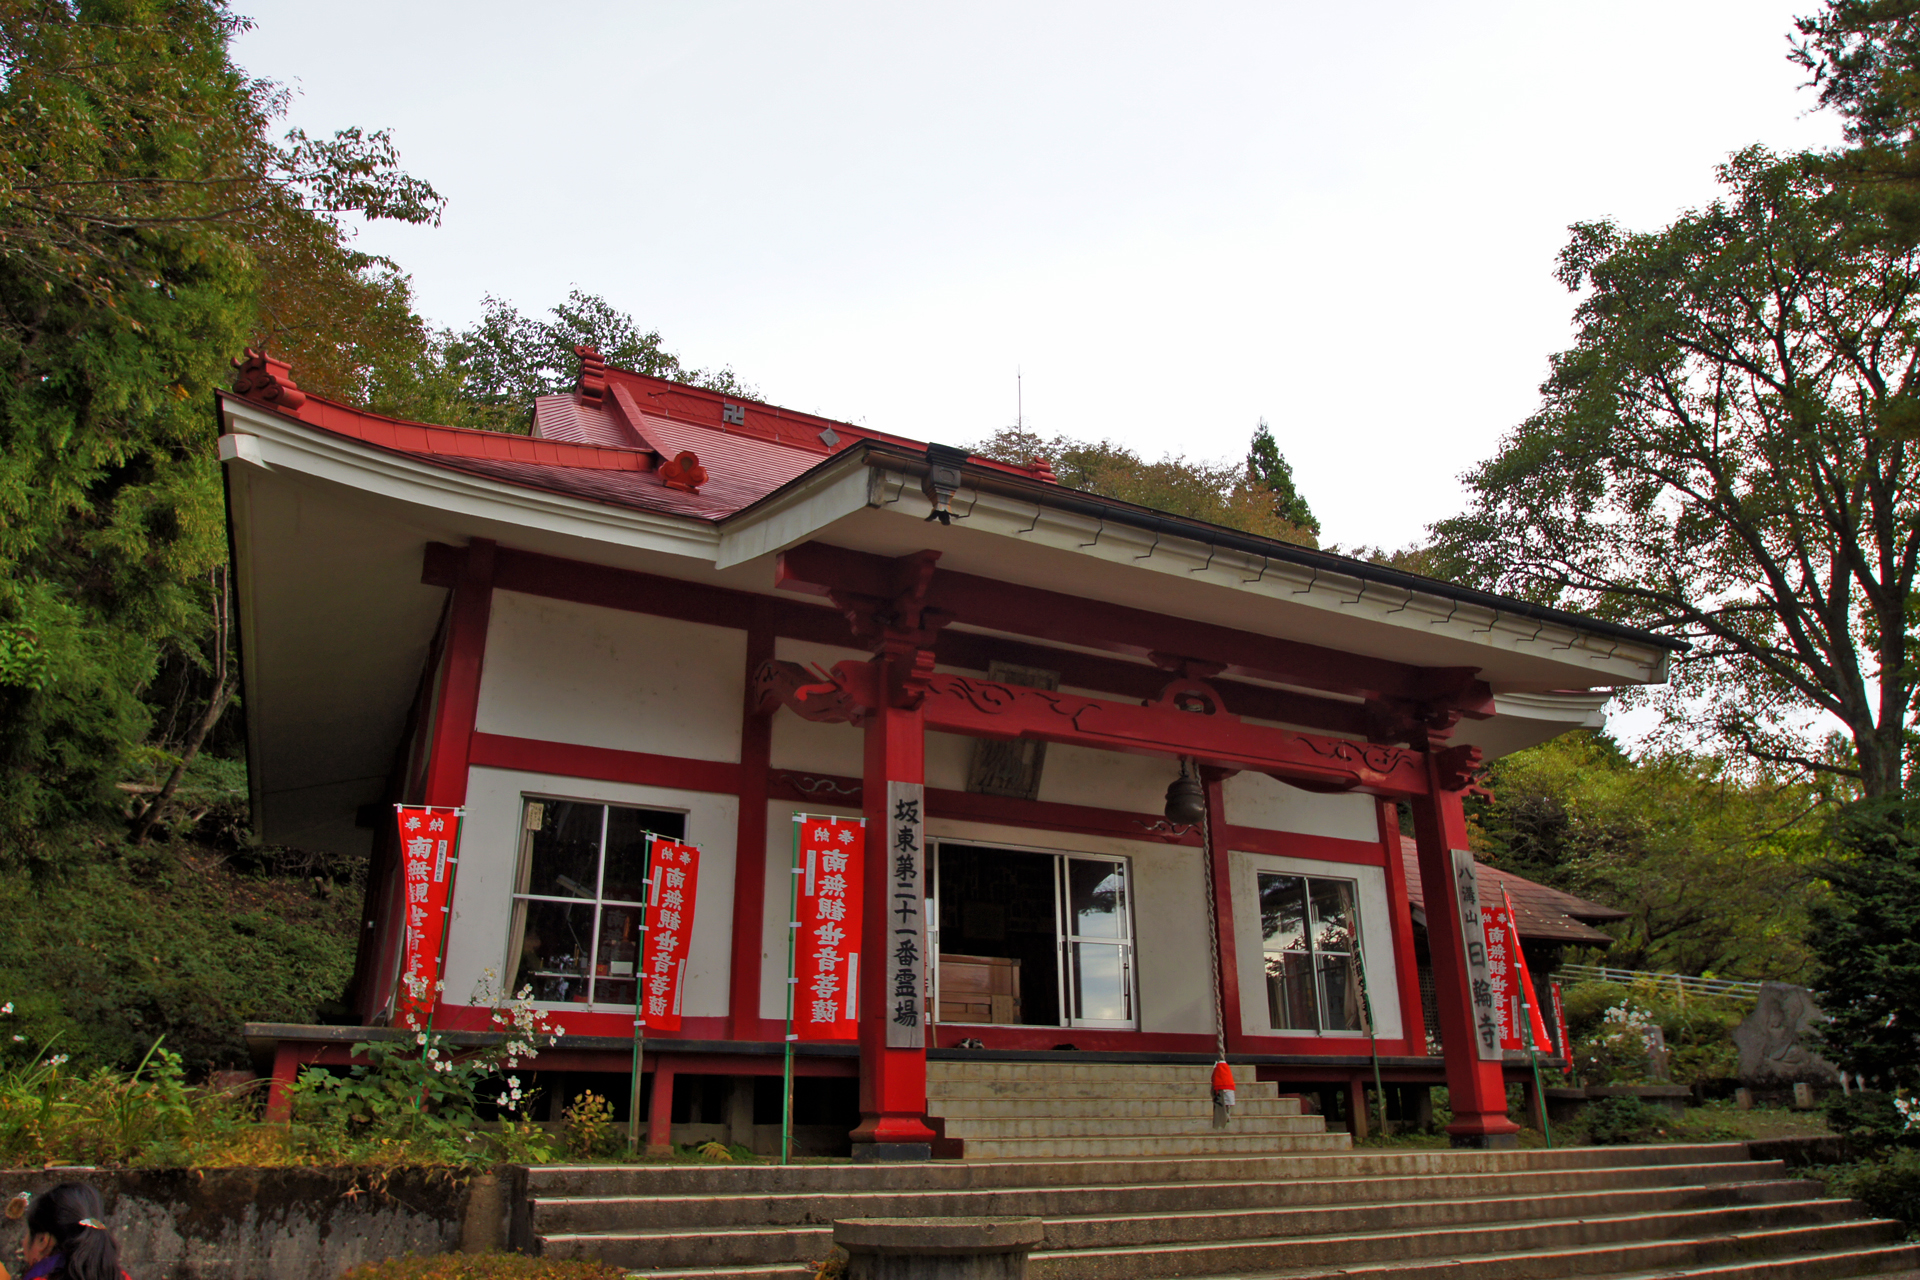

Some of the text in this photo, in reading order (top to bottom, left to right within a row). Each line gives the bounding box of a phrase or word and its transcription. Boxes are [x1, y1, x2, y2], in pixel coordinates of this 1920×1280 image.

[405, 816, 445, 832] 奉納
[407, 835, 434, 998] 南無観世音菩
[893, 798, 920, 1028] 坂東第二十一番霊場
